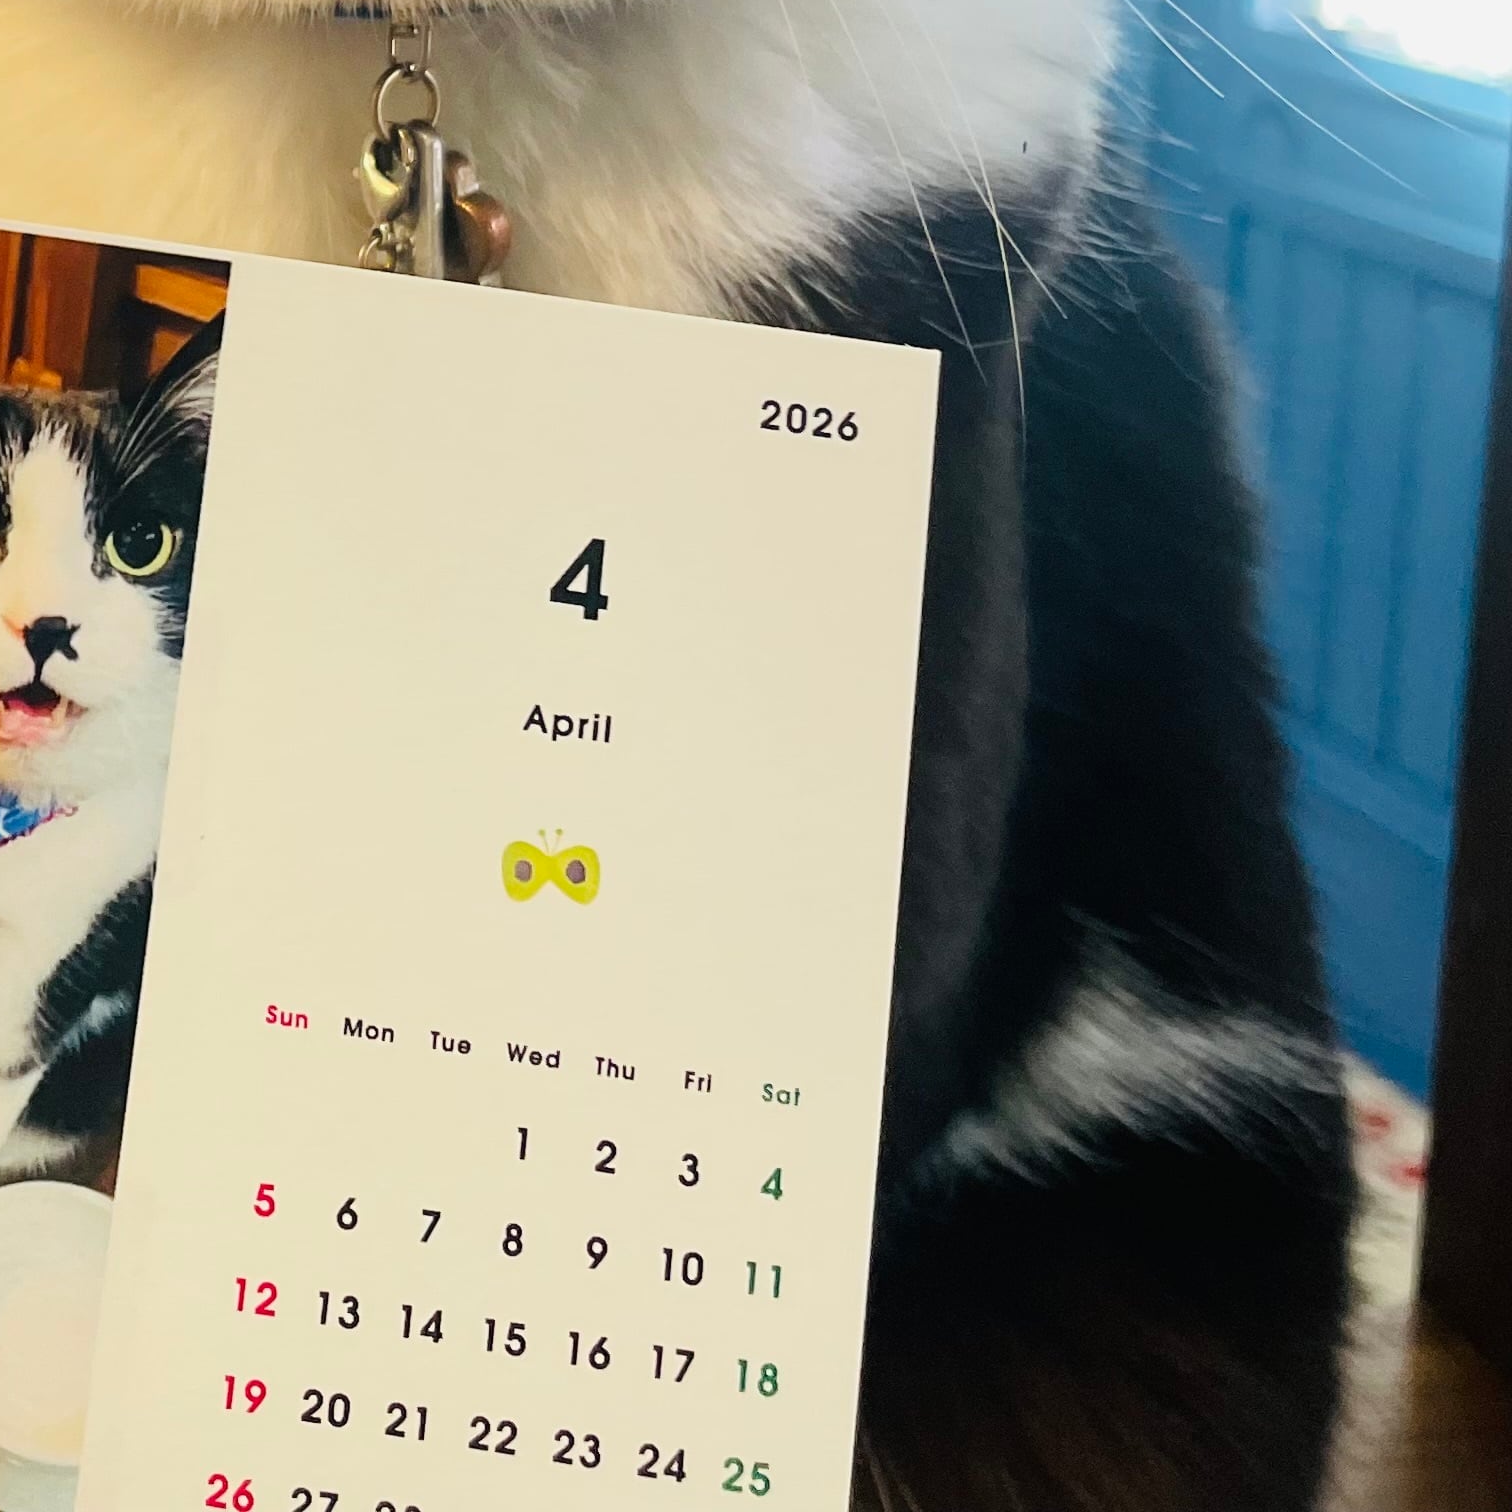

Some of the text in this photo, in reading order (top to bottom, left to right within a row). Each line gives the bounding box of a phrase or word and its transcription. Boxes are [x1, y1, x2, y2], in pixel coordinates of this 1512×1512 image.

[758, 398, 860, 443] 2026
[548, 536, 610, 623] 4
[521, 703, 613, 745] April
[264, 1003, 802, 1108] Sun Mon Tue Wed Thu Fri Sat
[516, 1125, 785, 1202] 1 2 3 4
[252, 1182, 783, 1300] 5 6 7 8 9 10 11
[234, 1276, 780, 1399] 12 13 14 15 16 17 18
[223, 1373, 772, 1498] 19 20 21 22 23 24 25
[204, 1472, 340, 1512] 26 27
